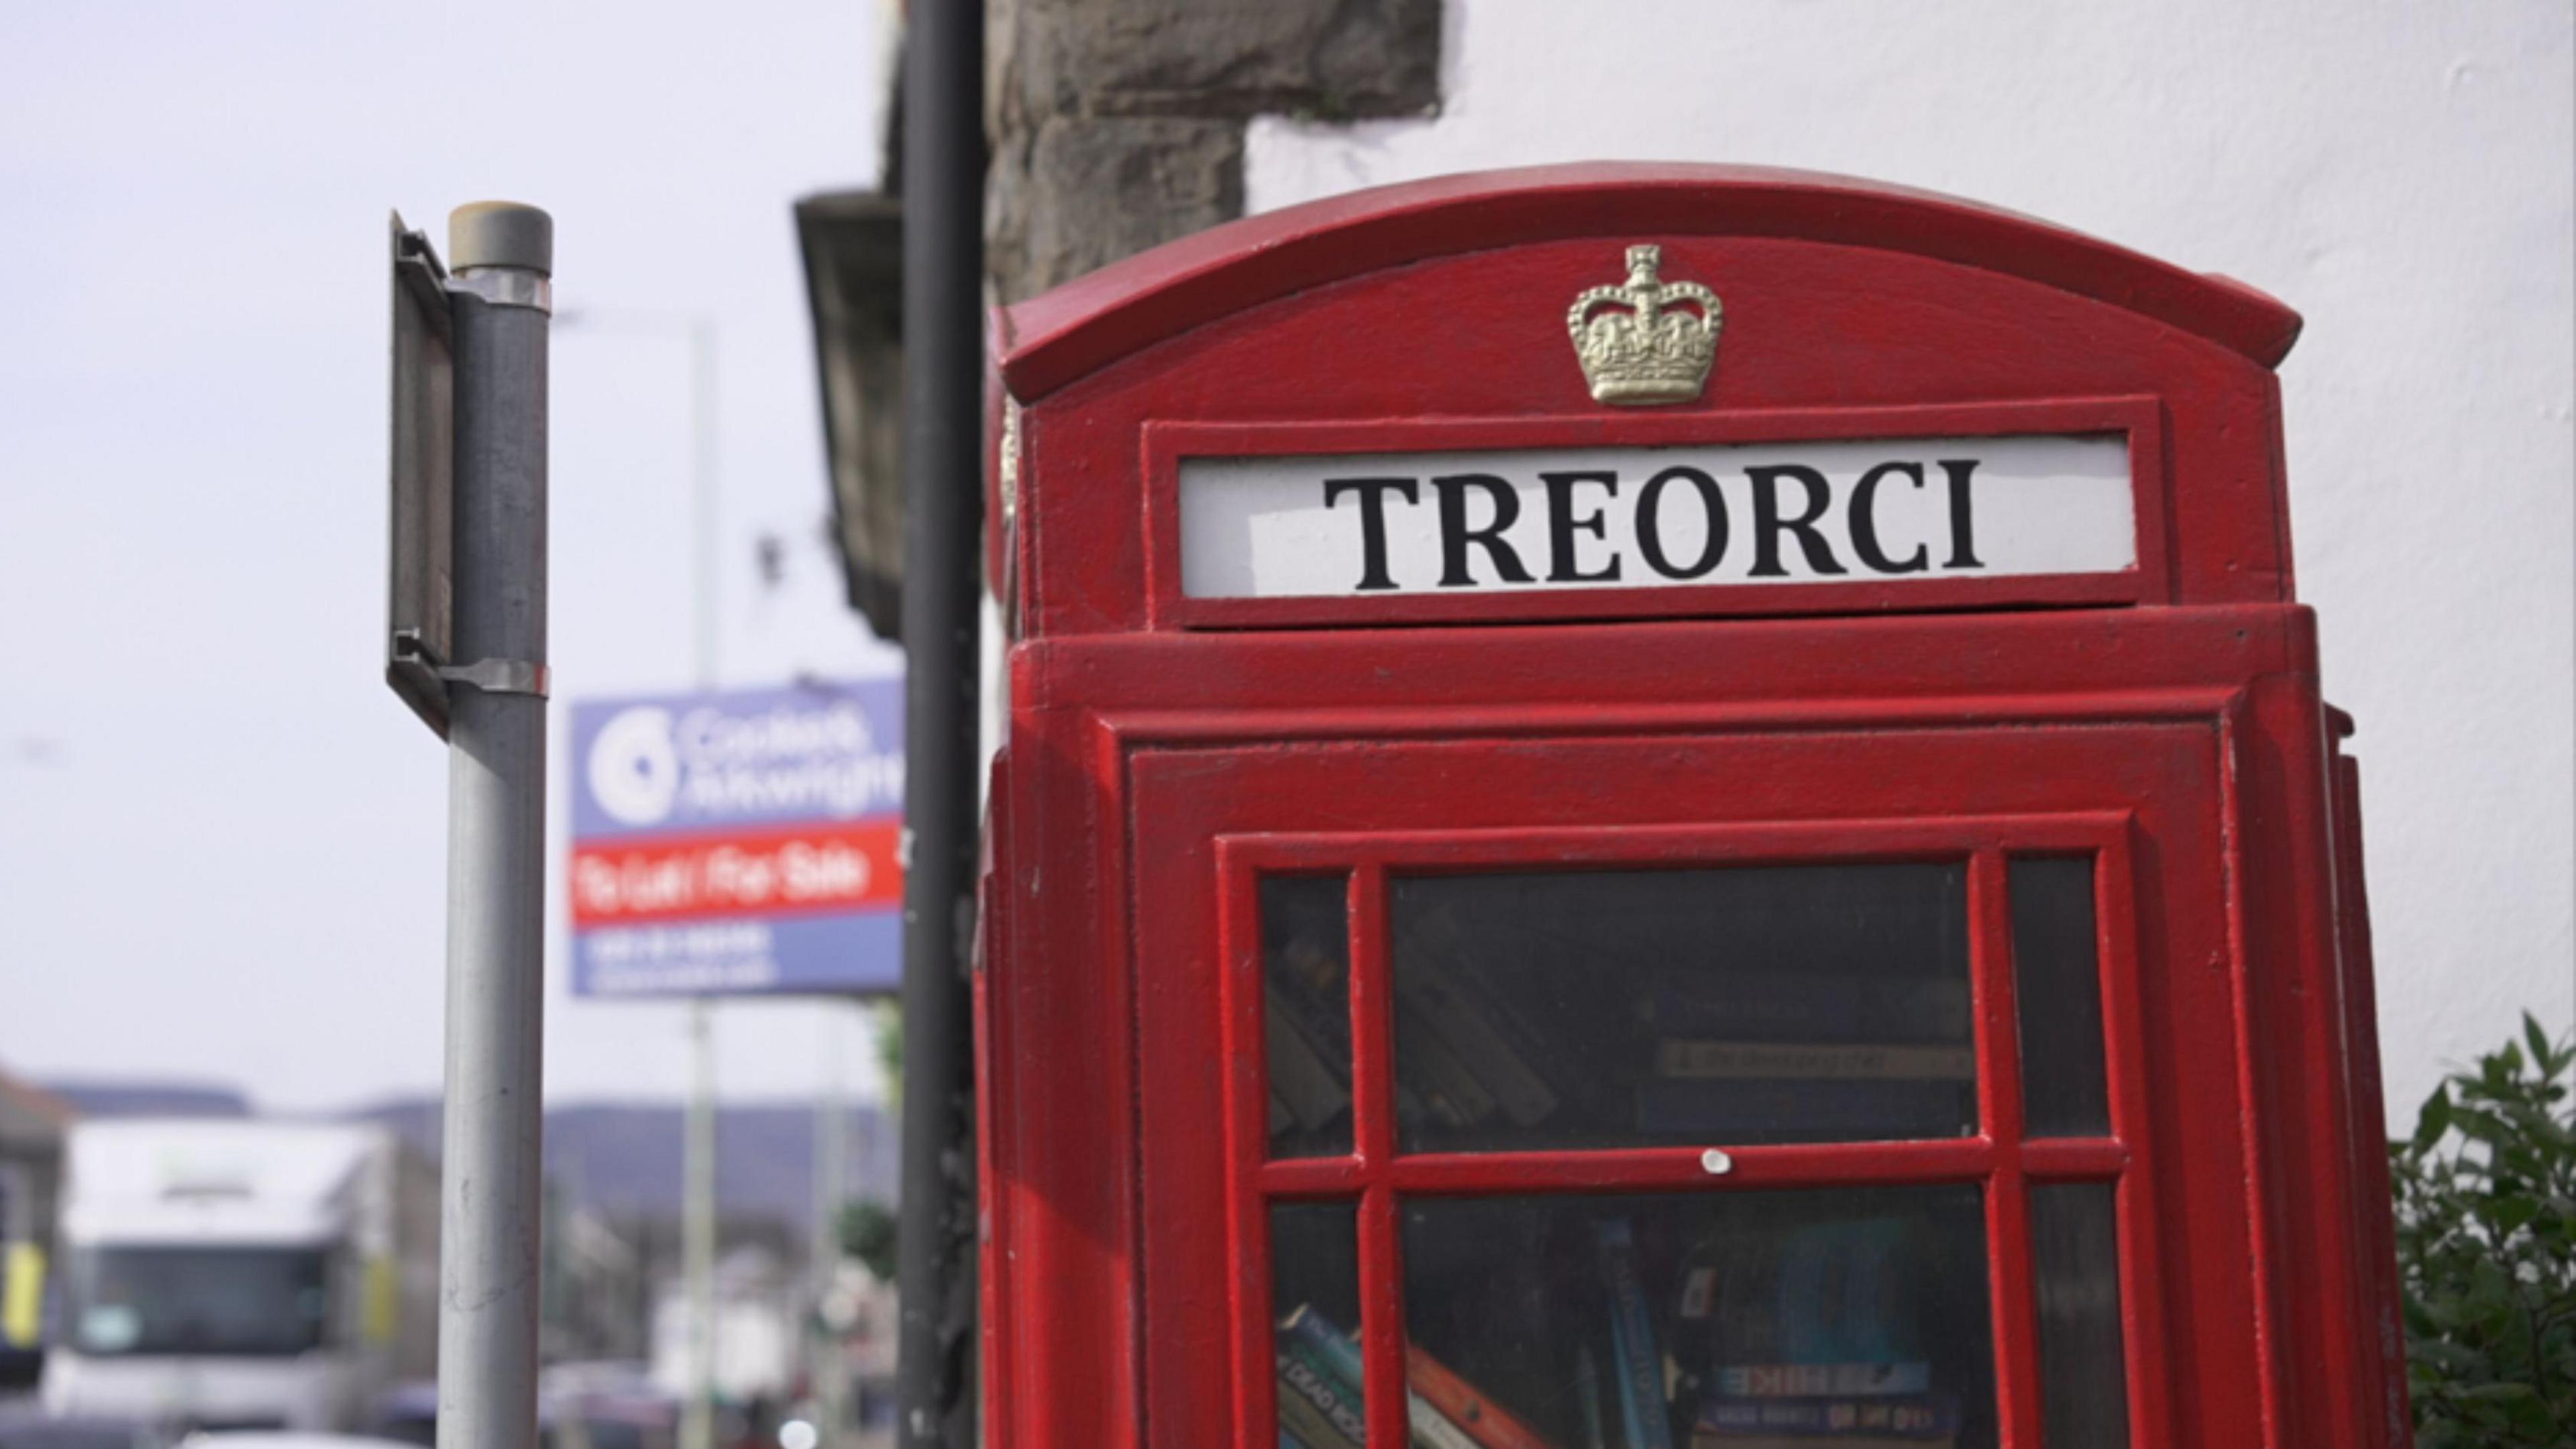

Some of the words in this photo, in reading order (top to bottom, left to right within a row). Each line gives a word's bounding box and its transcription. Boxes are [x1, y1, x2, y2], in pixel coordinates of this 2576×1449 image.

[1324, 460, 1984, 590] TREORCI
[711, 849, 774, 899] For
[780, 841, 866, 898] Sale
